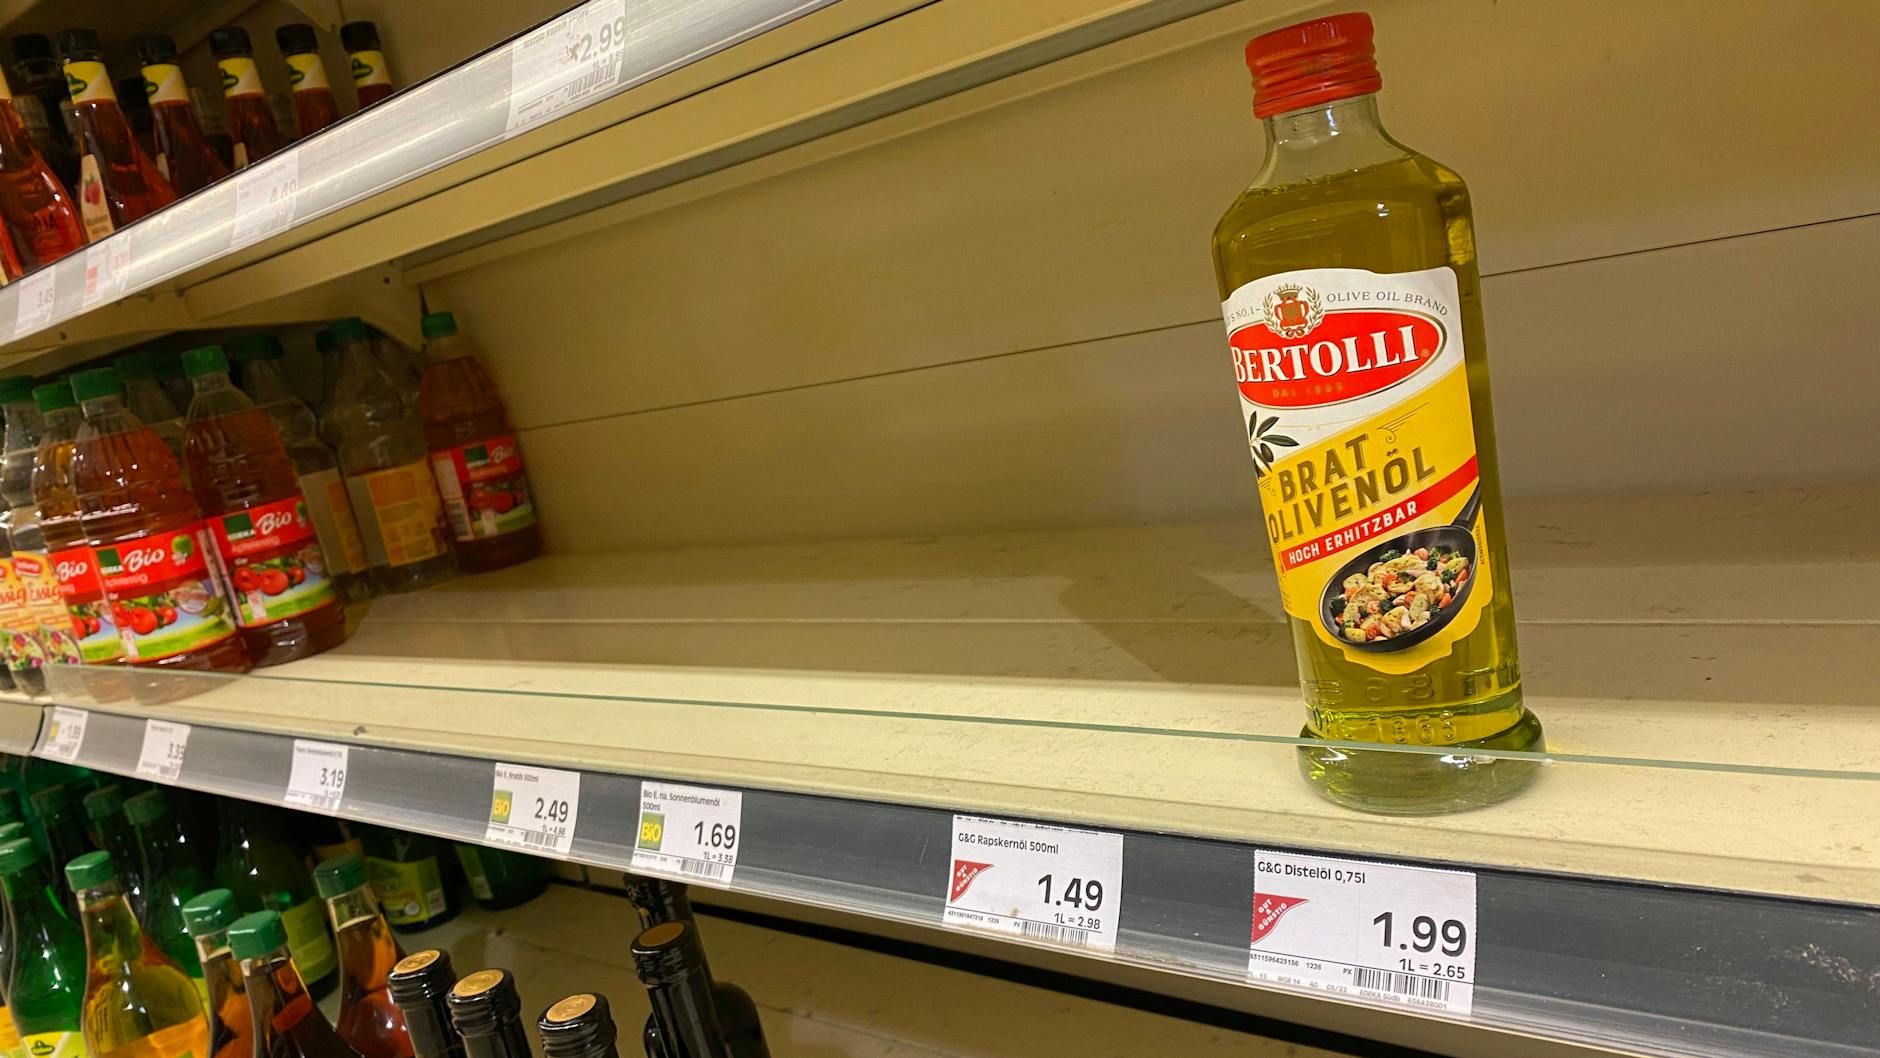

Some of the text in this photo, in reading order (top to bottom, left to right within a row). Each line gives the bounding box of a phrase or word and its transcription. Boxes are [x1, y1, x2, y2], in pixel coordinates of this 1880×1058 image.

[580, 16, 625, 62] 2.99
[1326, 290, 1449, 317] OLIVE OIL BRAND
[1230, 324, 1419, 384] BERTOLLI
[1278, 433, 1370, 504] BRAT
[1268, 447, 1437, 544] OLIVENÖL
[256, 511, 292, 536] Bio
[1288, 500, 1418, 566] HOCH ERHITZBAR
[57, 560, 88, 582] Bio
[123, 547, 166, 573] Bio
[320, 767, 344, 788] 3.19
[534, 796, 569, 823] 2.49
[642, 802, 661, 811] 500ml
[643, 789, 652, 799] Bio
[669, 793, 720, 807] Sonnenblumenöl
[694, 820, 736, 850] 1.69
[958, 832, 1059, 855] G&G Rapskernöl 500ml
[703, 851, 711, 861] 1L
[718, 854, 734, 864] 3.38
[1257, 861, 1366, 884] G&G Distelöl 0,75l
[1037, 873, 1104, 912] 1.49
[1258, 898, 1272, 914] GUT
[1258, 902, 1288, 931] GÜNSTIG
[1054, 912, 1066, 924] 1L
[1077, 916, 1101, 930] 2.98
[1373, 911, 1467, 957] 1.99
[1305, 962, 1322, 970] 1226
[1342, 967, 1352, 975] PX
[1399, 958, 1415, 972] 1L
[1433, 964, 1466, 979] 2.65
